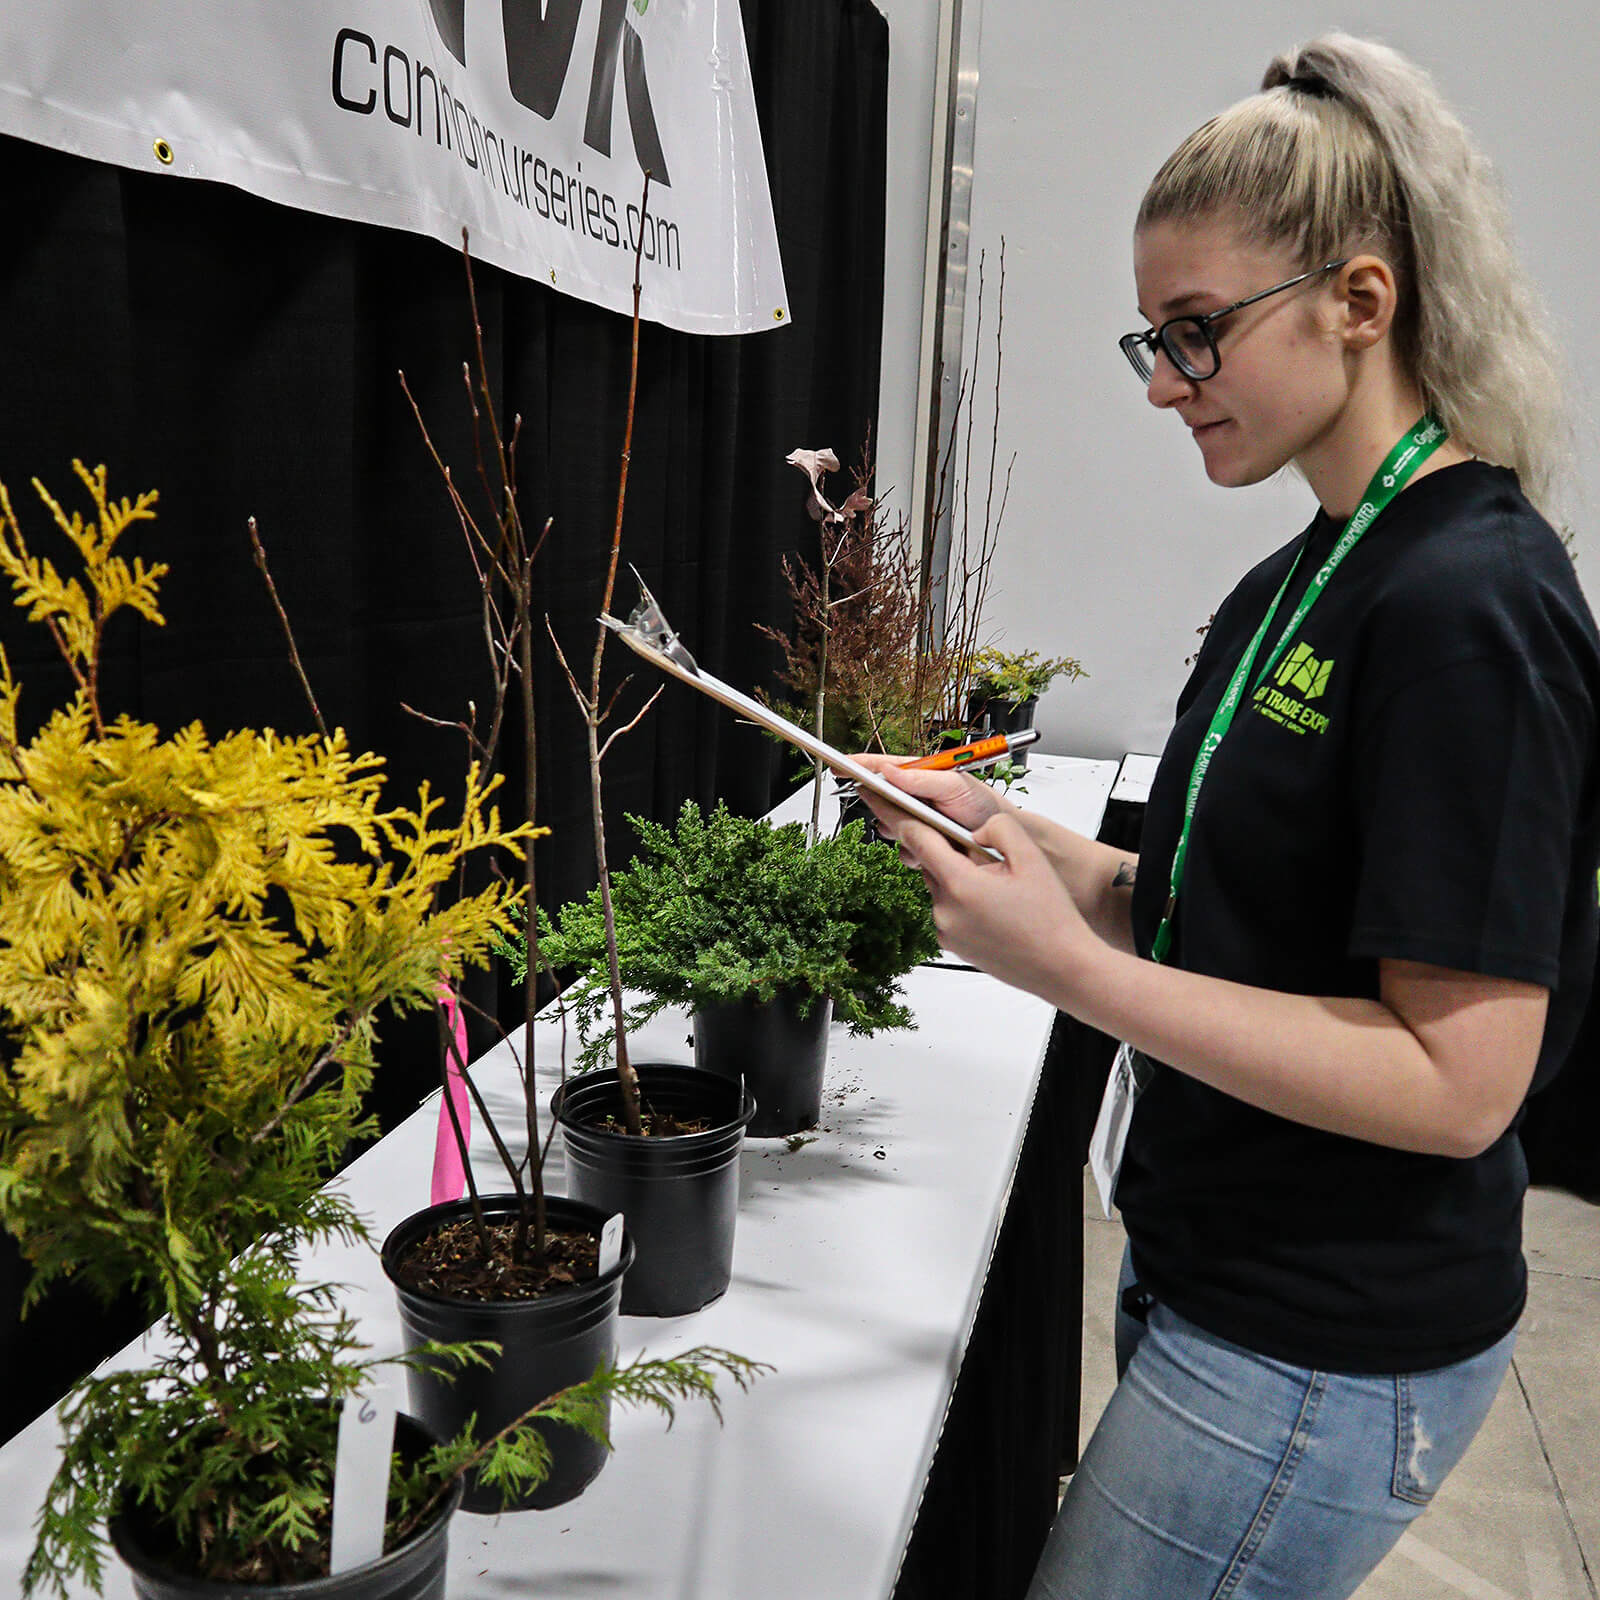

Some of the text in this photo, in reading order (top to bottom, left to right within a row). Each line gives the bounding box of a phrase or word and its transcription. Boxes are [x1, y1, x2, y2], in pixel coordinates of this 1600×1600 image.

[332, 28, 681, 270] connonnurseries.com
[1265, 688, 1304, 719] TRADE
[358, 1400, 377, 1425] 6
